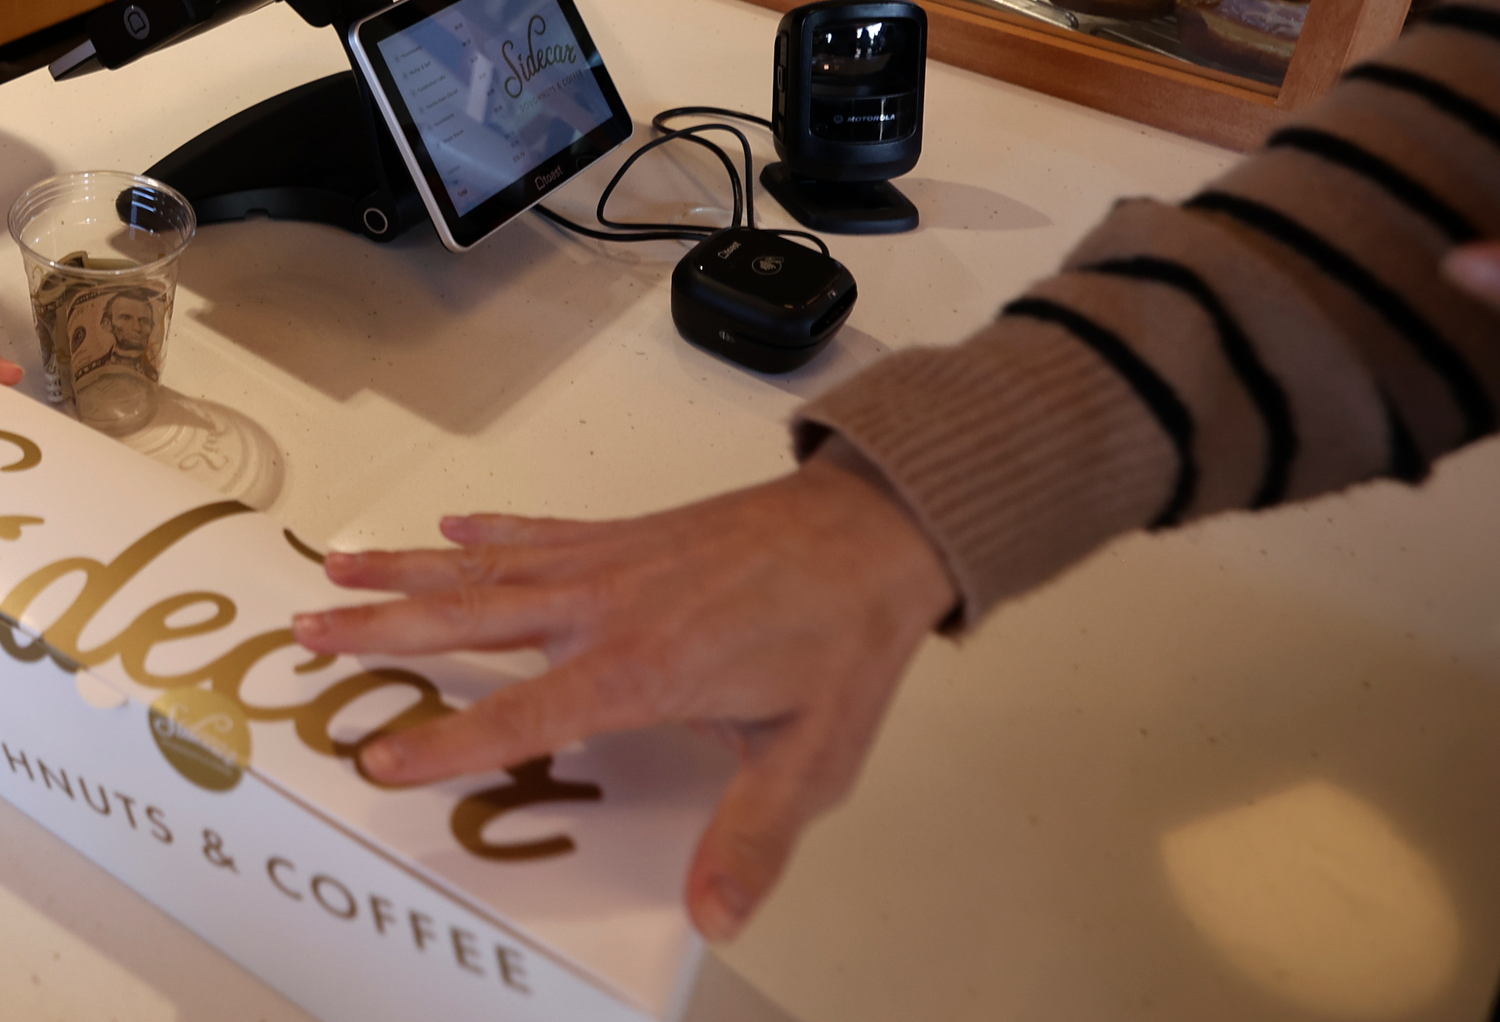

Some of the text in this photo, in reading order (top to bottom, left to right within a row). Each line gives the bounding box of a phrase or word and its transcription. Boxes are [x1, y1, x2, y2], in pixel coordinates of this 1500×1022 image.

[502, 14, 576, 99] Sidecar
[520, 84, 557, 112] DOUGHNUTS
[847, 113, 896, 123] MOTOROLA
[202, 828, 240, 875] &
[266, 855, 533, 998] COFFEE
